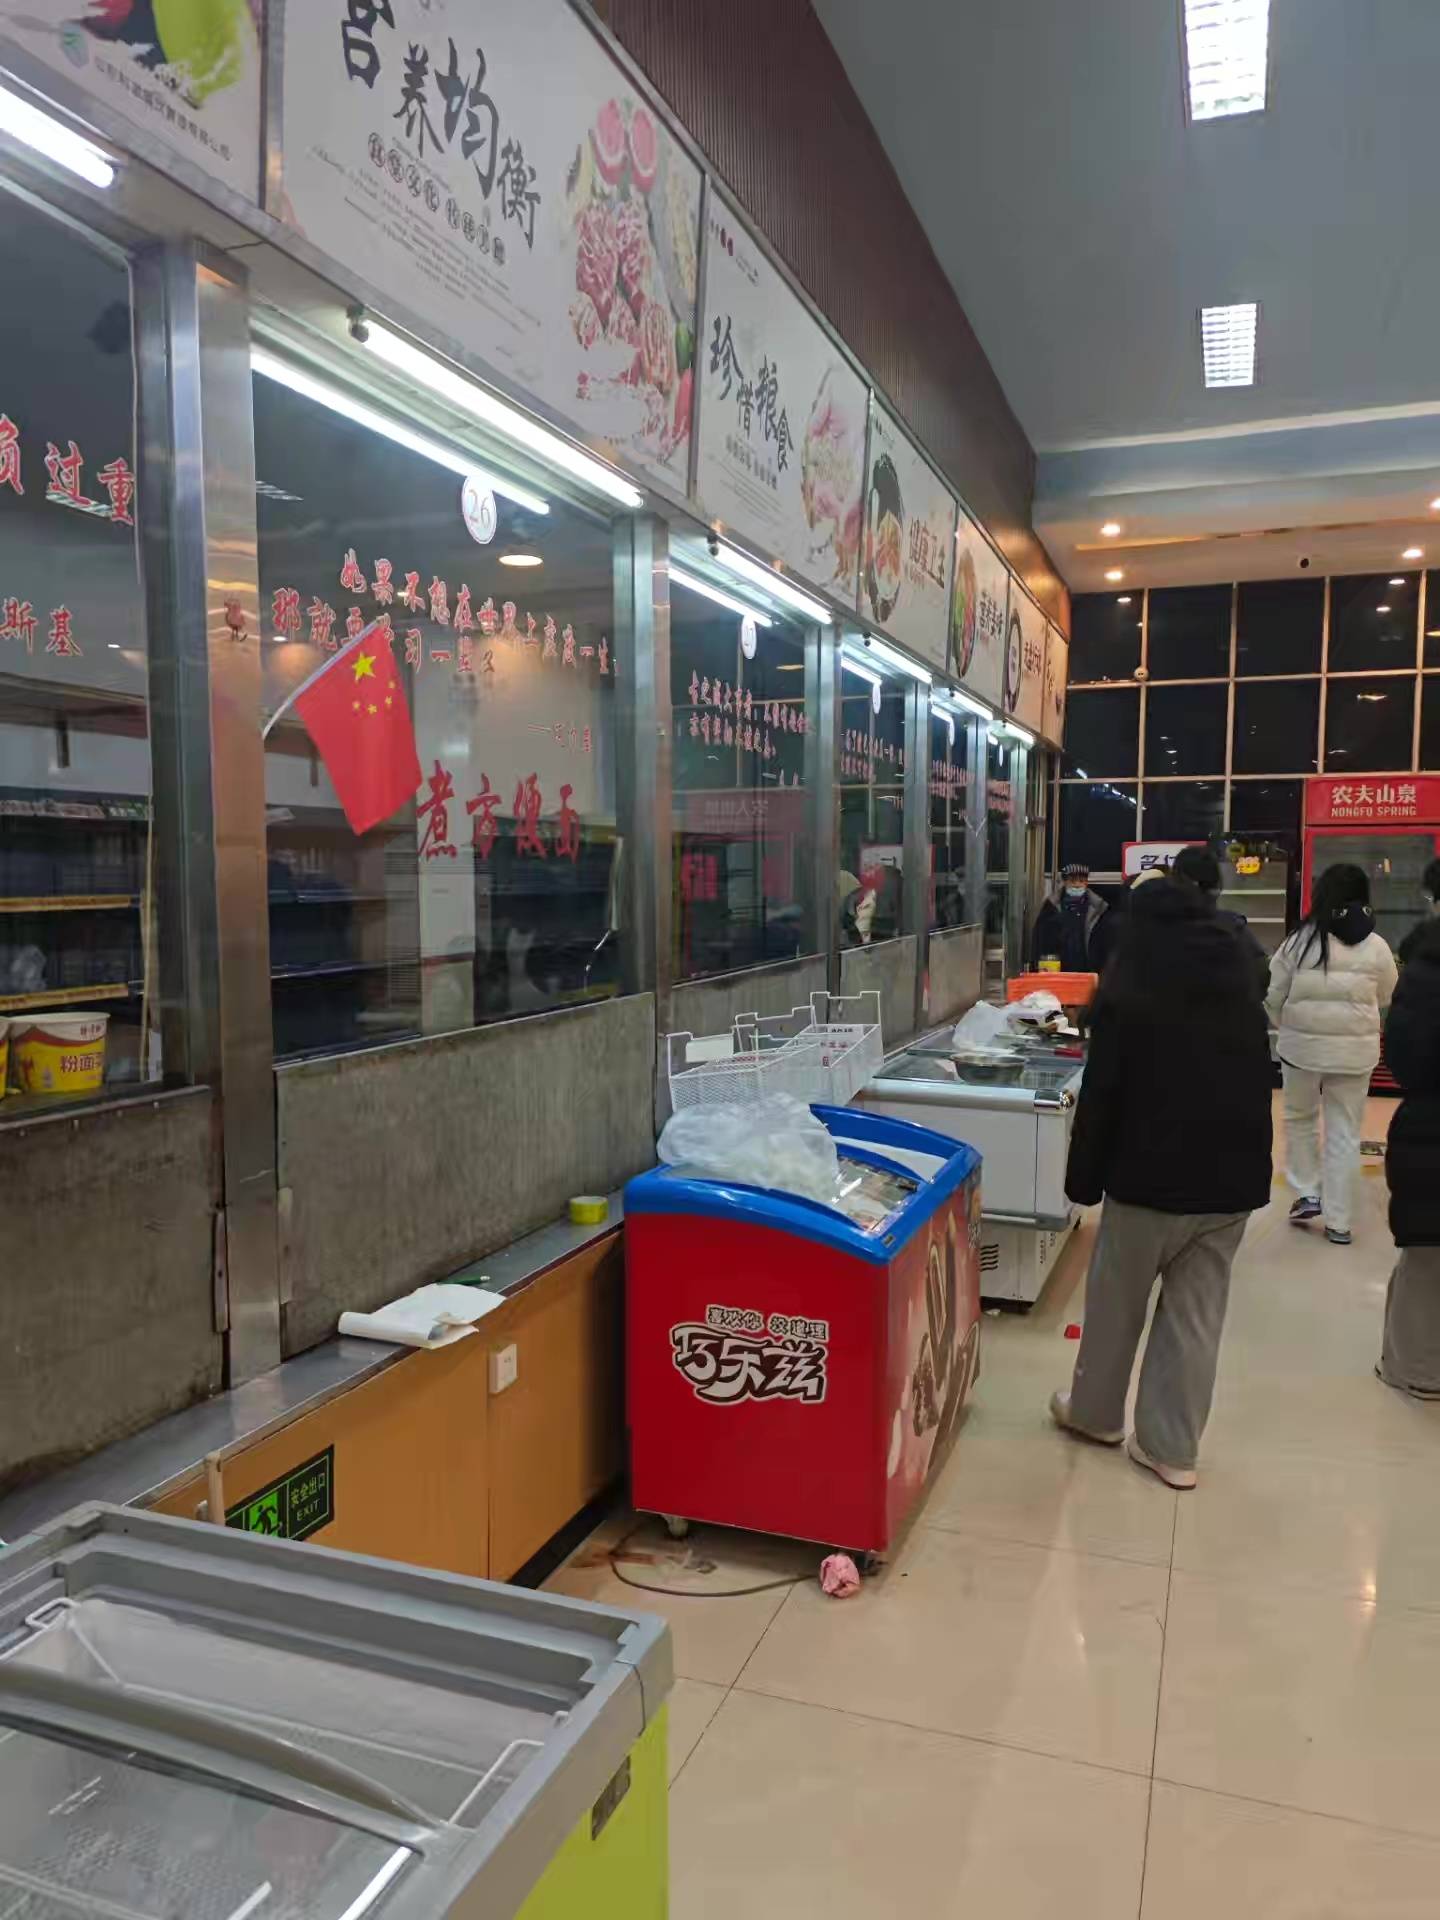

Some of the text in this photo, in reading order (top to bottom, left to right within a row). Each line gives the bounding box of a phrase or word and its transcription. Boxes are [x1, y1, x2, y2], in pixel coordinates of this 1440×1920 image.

[710, 316, 794, 472] 珍惜粮食
[469, 488, 490, 529] 26
[1332, 784, 1416, 804] 农夫山泉
[1332, 806, 1416, 817] NONGFU SPRING
[708, 1307, 826, 1340] 喜欢你 没道理
[672, 1324, 827, 1403] 巧乐兹
[291, 1473, 325, 1505] 安全出口
[297, 1500, 319, 1521] EXIT
